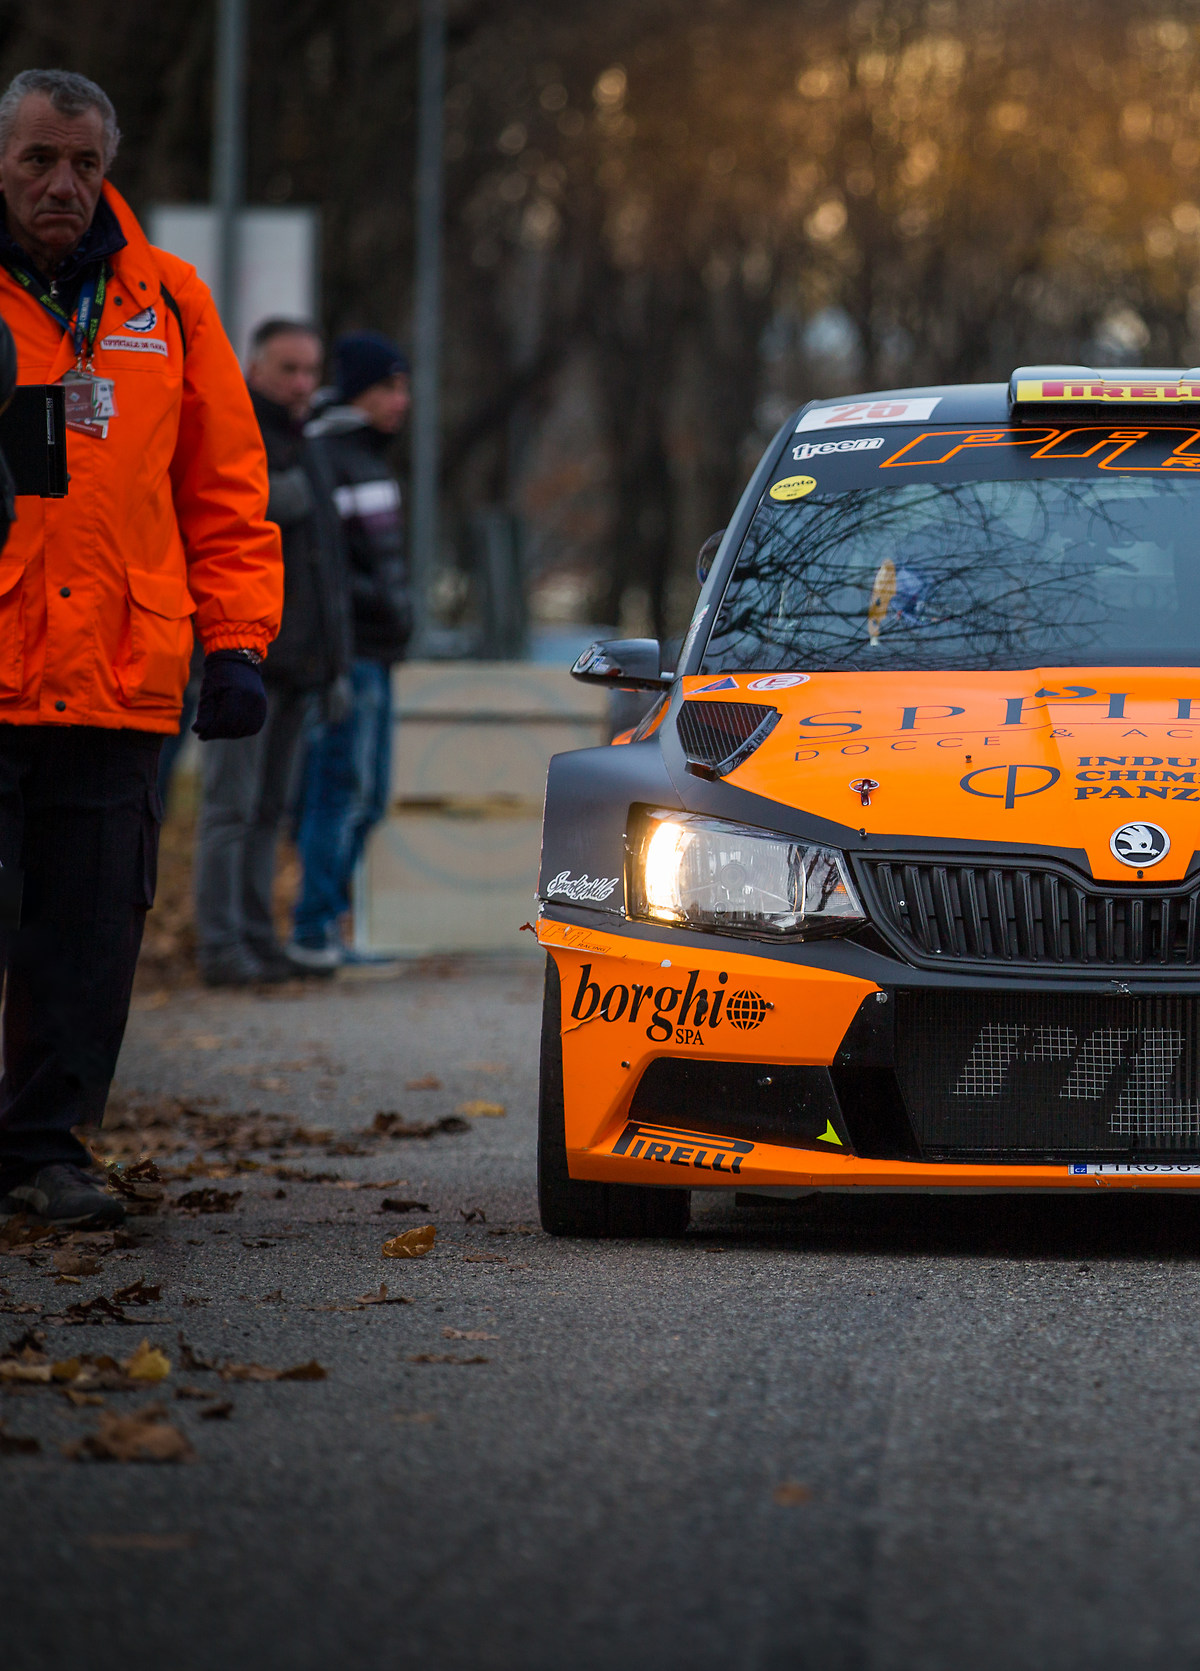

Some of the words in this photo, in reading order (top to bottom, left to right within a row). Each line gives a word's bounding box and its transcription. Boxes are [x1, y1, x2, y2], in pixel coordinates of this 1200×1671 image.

[793, 437, 885, 460] freem
[794, 736, 1001, 762] DOCCE
[1049, 728, 1076, 738] &
[570, 963, 729, 1043] borghi
[675, 1028, 705, 1046] SPA
[611, 1121, 755, 1175] PIRELLI
